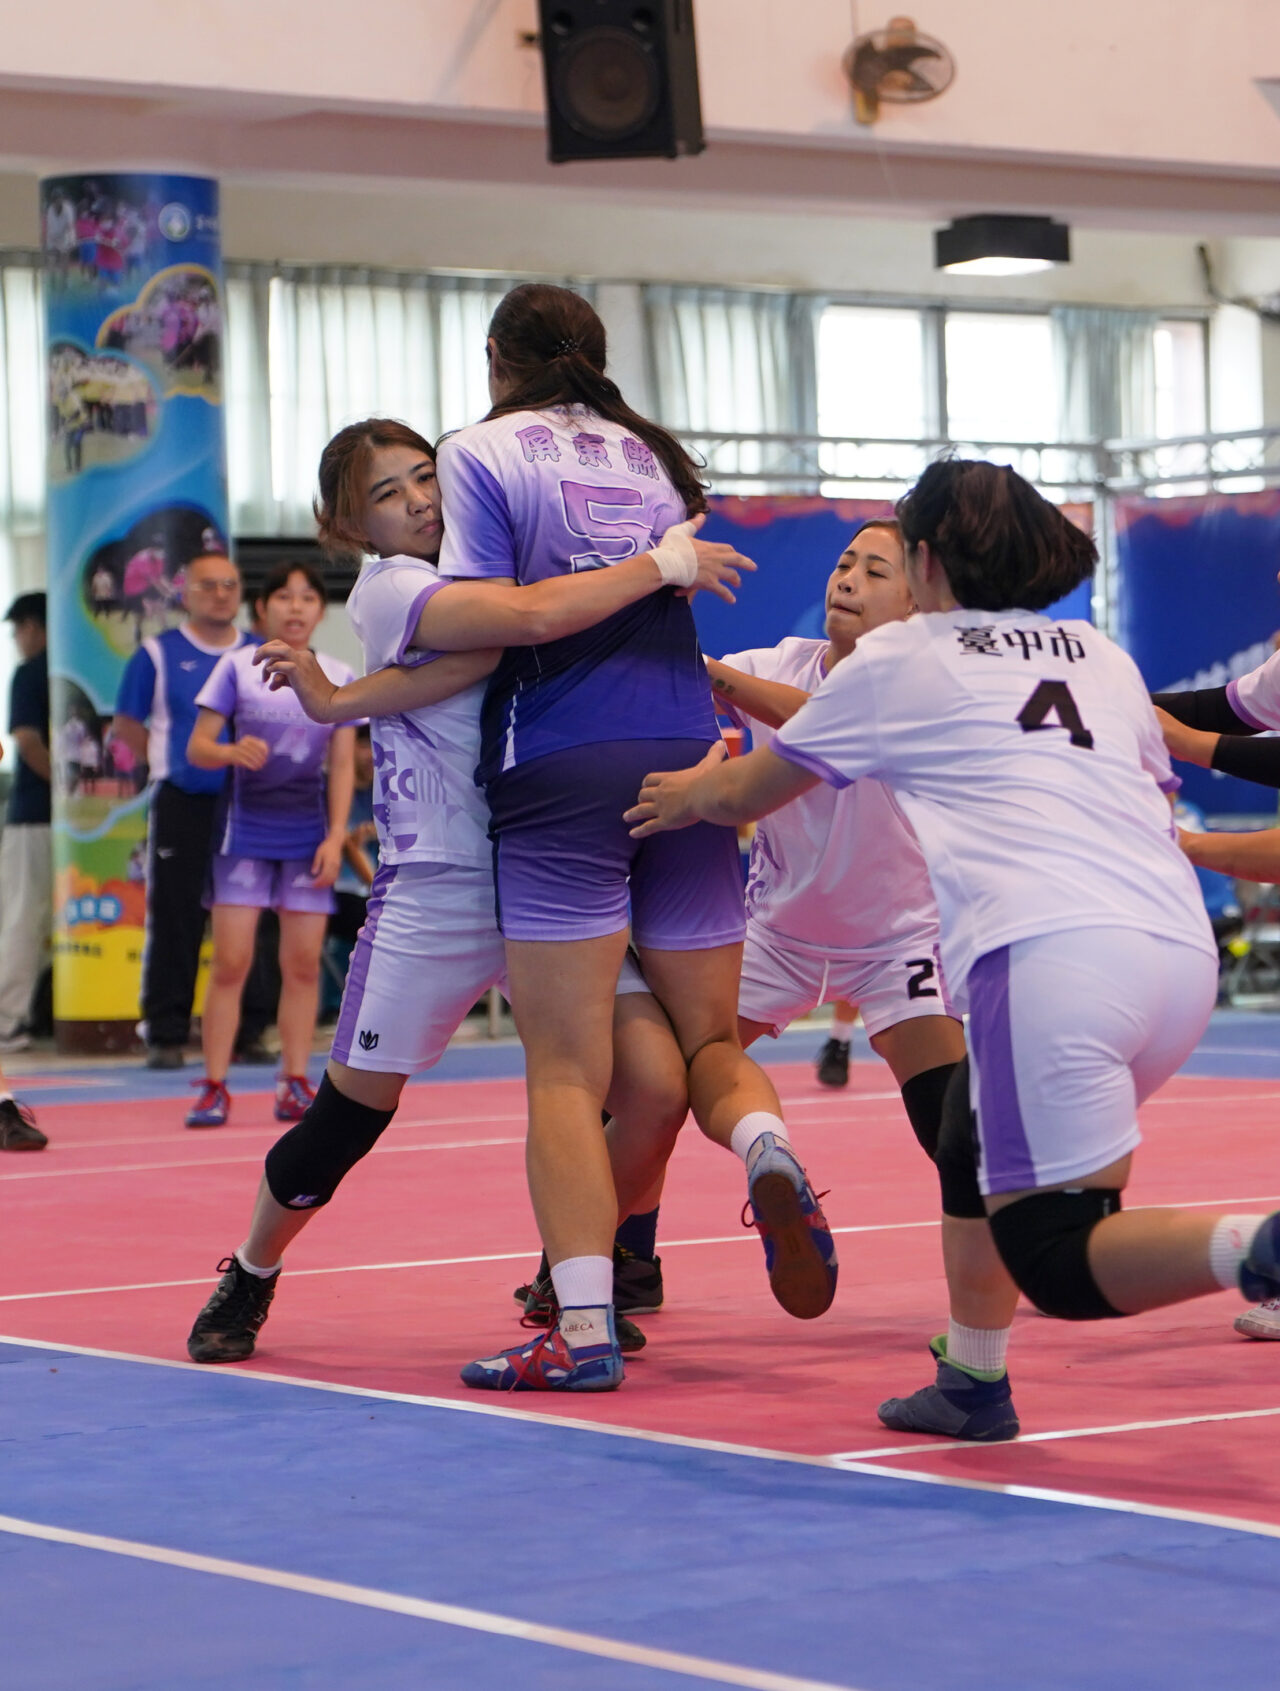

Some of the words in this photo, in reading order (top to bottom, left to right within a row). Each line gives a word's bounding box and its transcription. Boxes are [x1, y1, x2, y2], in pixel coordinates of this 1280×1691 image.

[559, 479, 662, 573] 5
[952, 624, 1087, 664] 臺中市
[1014, 679, 1096, 751] 4
[905, 958, 939, 1000] 2
